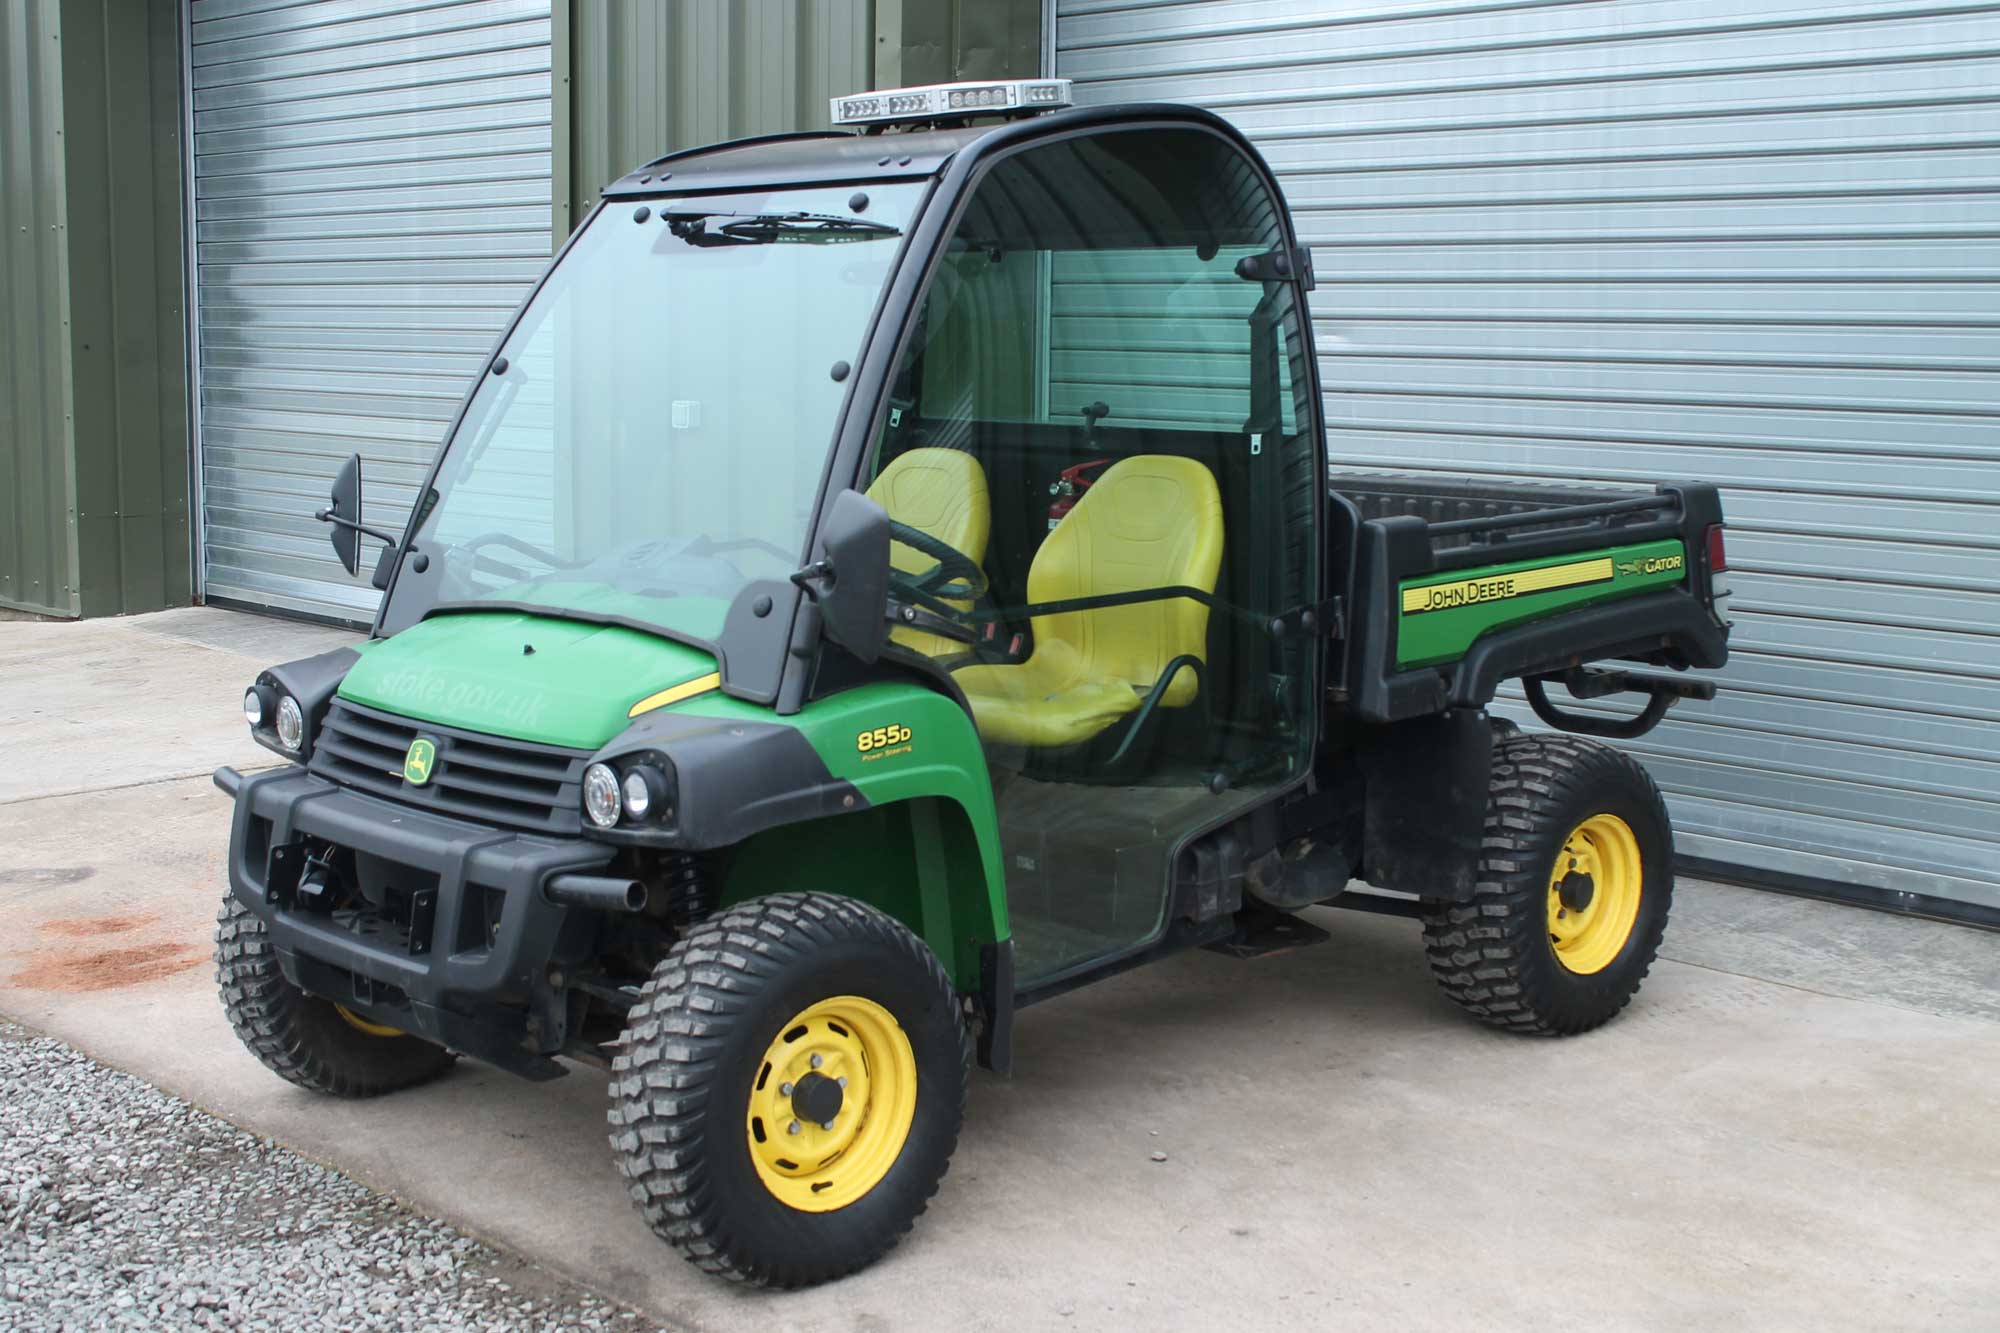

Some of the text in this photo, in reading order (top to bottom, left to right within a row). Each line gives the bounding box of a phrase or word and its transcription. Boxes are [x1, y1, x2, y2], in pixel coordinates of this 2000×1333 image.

[1645, 555, 1682, 574] GATOR
[1423, 579, 1515, 610] JOHN DEERE
[857, 723, 912, 752] 855D
